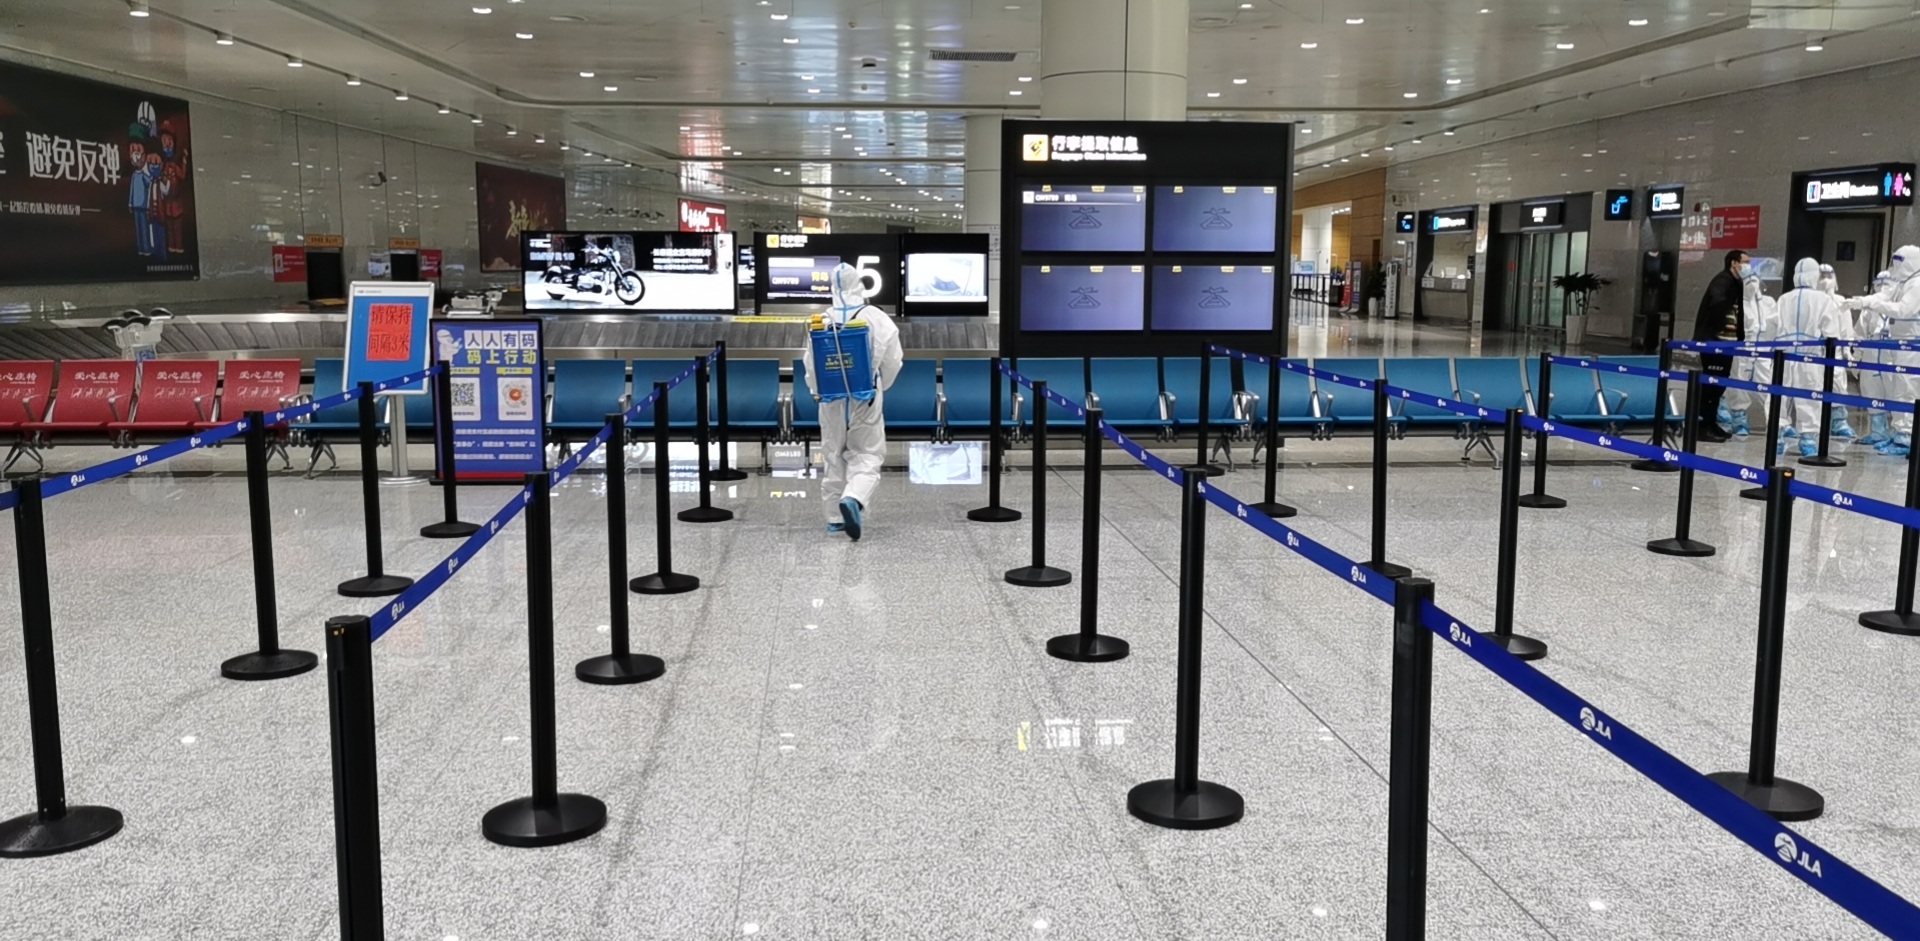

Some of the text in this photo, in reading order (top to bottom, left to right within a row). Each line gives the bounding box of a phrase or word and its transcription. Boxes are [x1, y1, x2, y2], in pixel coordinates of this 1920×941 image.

[1052, 135, 1139, 151] 行李提取信息
[26, 131, 121, 185] 避免反弹
[1821, 181, 1850, 199] 卫生间
[855, 255, 882, 298] 5
[371, 304, 411, 325] 请保持
[369, 333, 409, 352] 间隔3米
[466, 331, 537, 348] 人人有码
[467, 350, 537, 365] 码上行动
[0, 372, 37, 381] 心座椅
[1748, 471, 1757, 480] JLA
[1842, 497, 1853, 506] JLA
[1358, 572, 1367, 584] JLA
[1460, 631, 1471, 647] JLA
[1595, 720, 1611, 740] JLA
[1797, 851, 1822, 878] JLA
